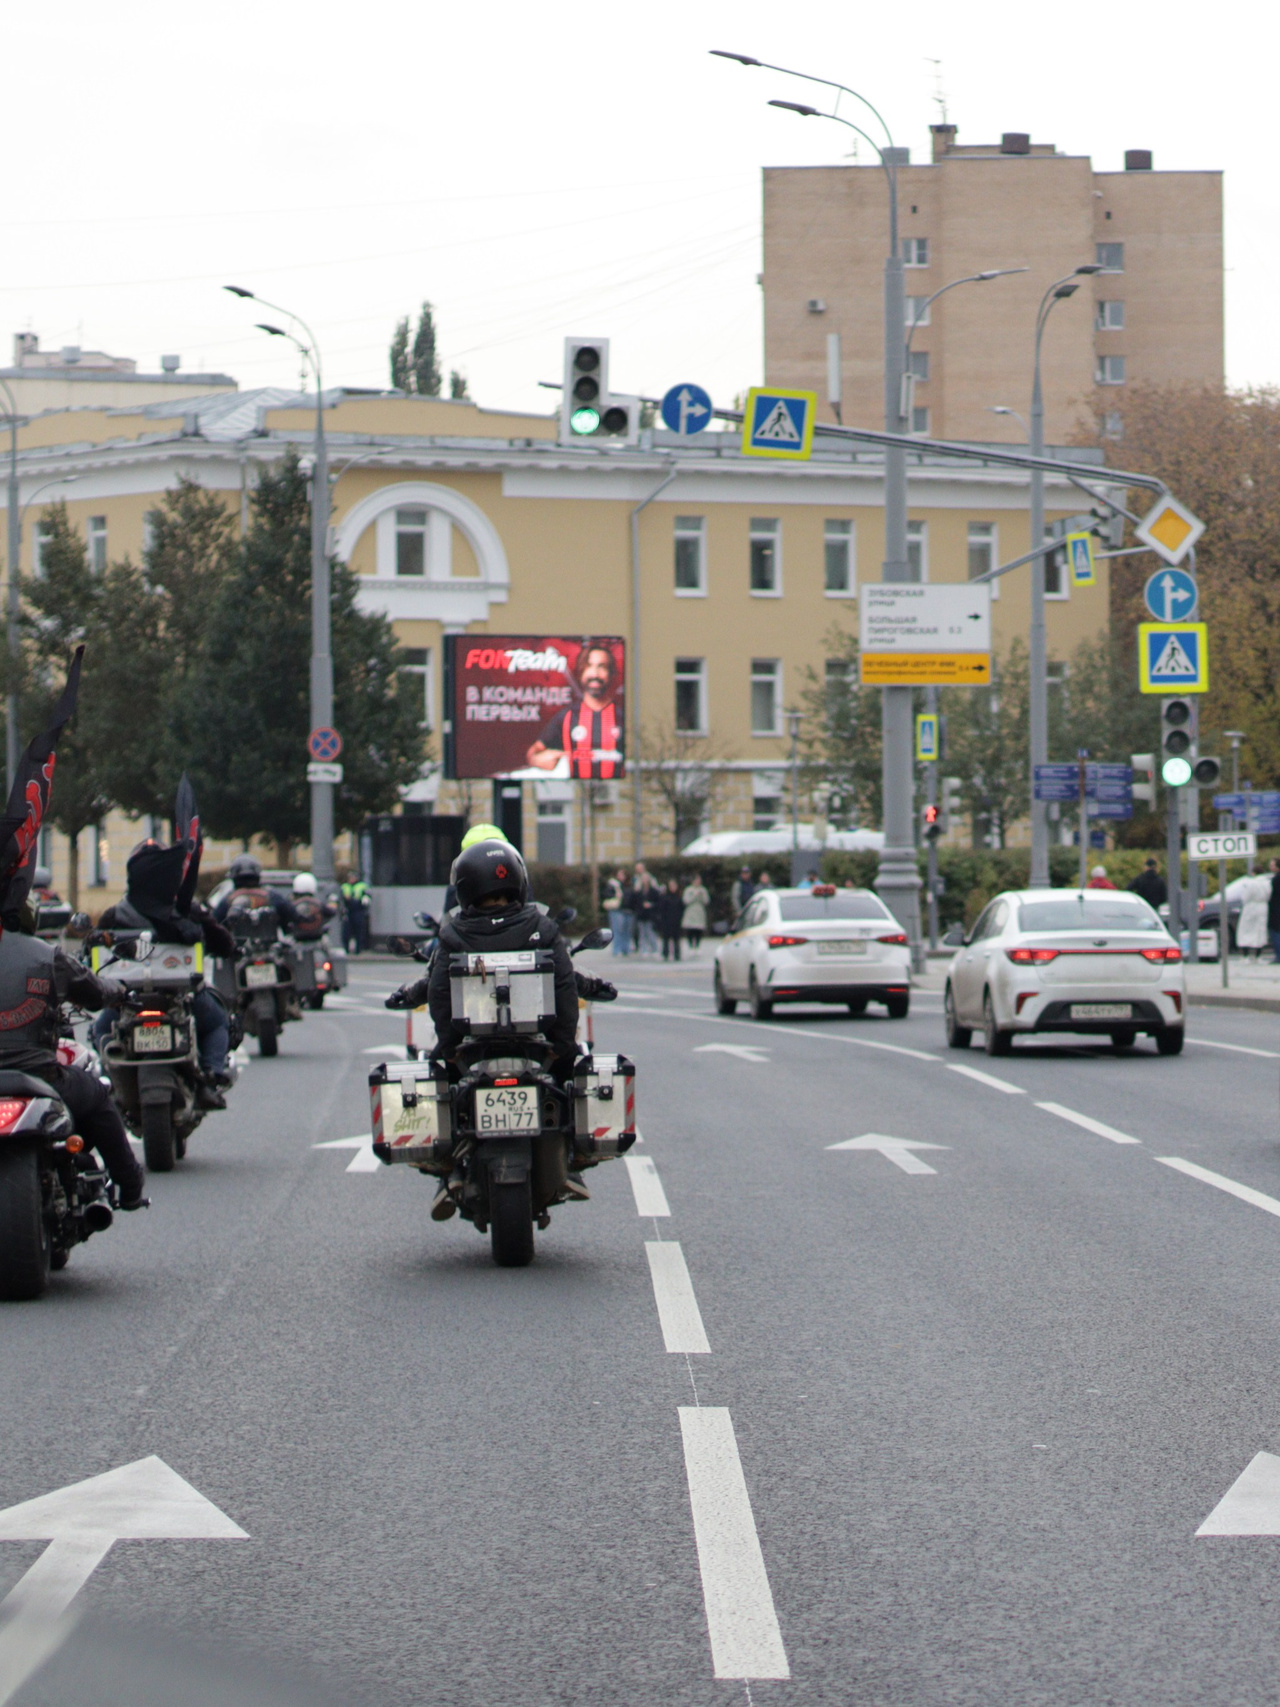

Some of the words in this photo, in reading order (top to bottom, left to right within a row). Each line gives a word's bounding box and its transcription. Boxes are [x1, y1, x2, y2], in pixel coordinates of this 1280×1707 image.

[465, 686, 480, 703] В
[482, 686, 573, 706] КОМАНДЕ
[465, 704, 541, 722] ПЕРВЫХ
[1197, 836, 1249, 856] СТОП
[485, 1090, 528, 1107] 6439
[513, 1112, 533, 1127] 77
